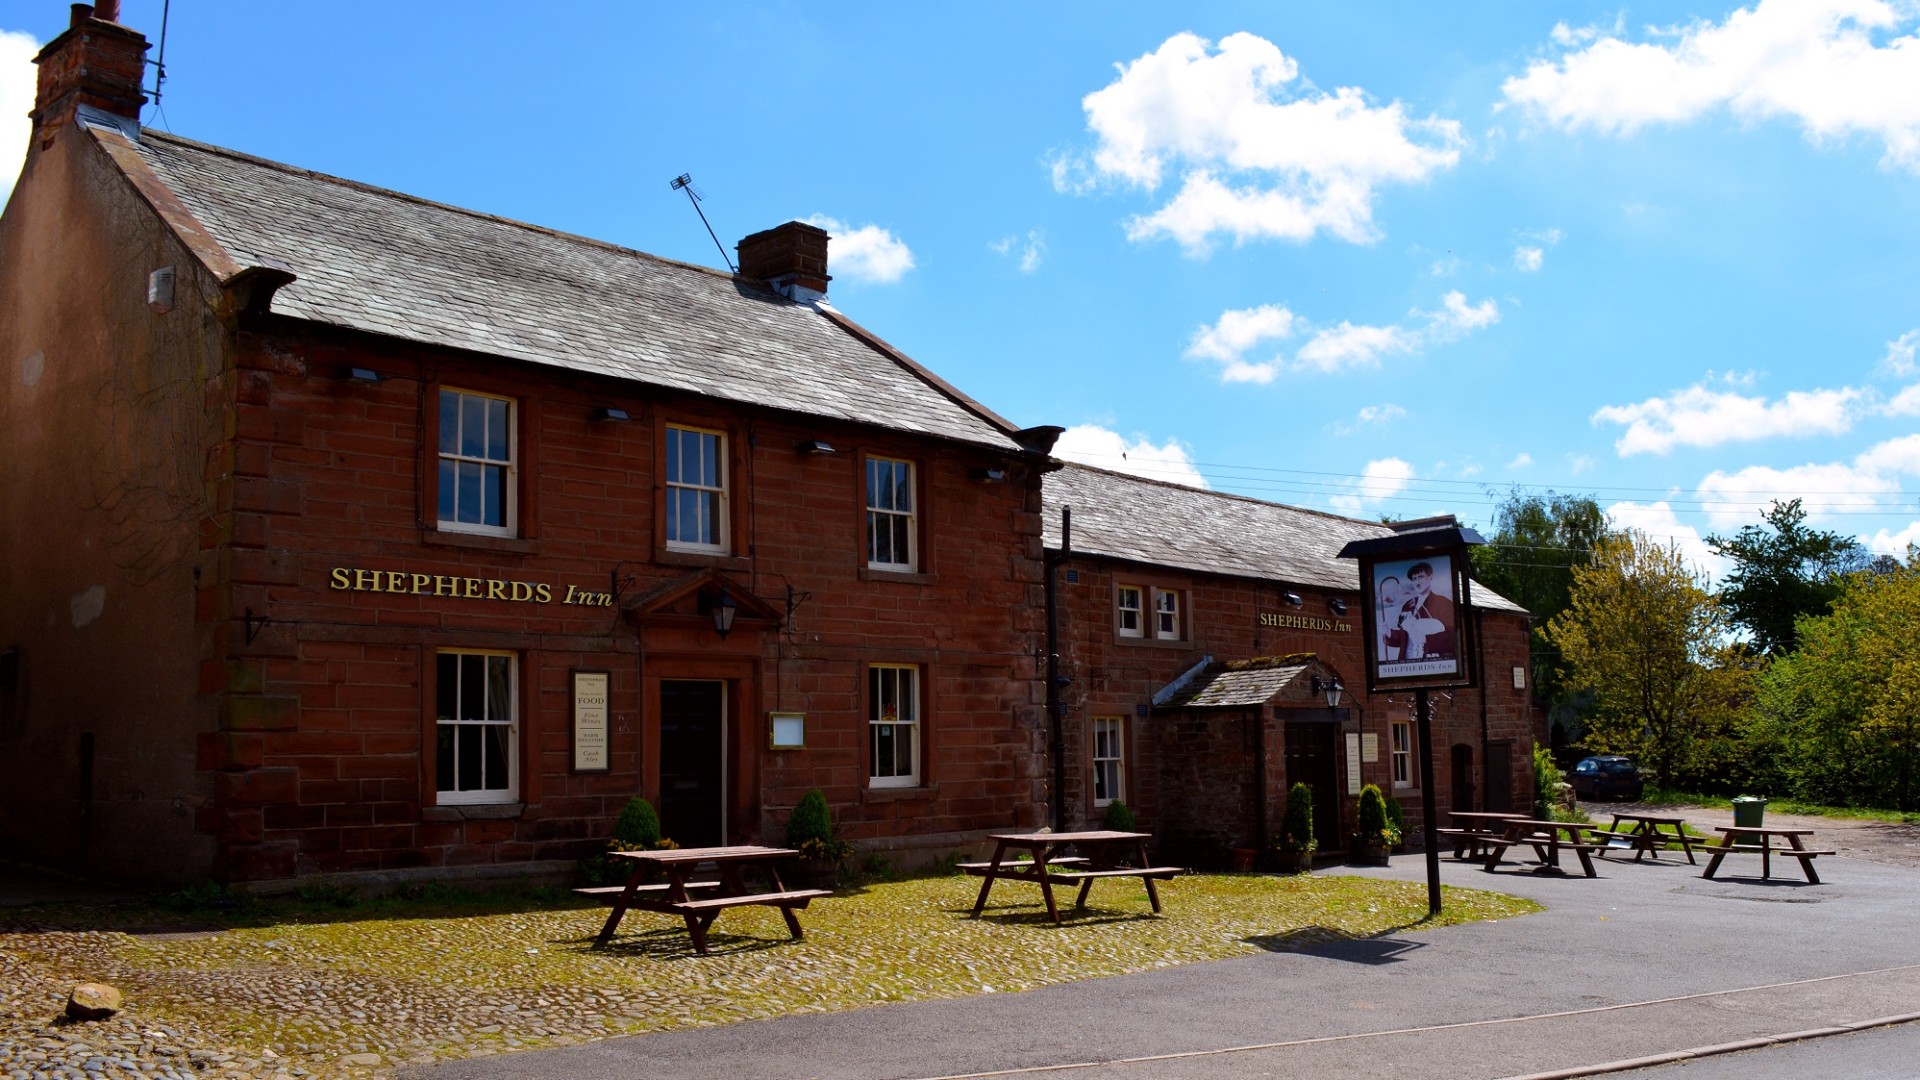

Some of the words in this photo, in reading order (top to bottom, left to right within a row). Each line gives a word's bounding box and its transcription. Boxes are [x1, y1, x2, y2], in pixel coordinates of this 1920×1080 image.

[330, 567, 552, 604] SHEPHERDS
[563, 584, 613, 608] Inn
[1260, 612, 1332, 632] SHEPHERDS
[1333, 619, 1352, 632] Inn
[1382, 664, 1436, 673] SHEPHERDS
